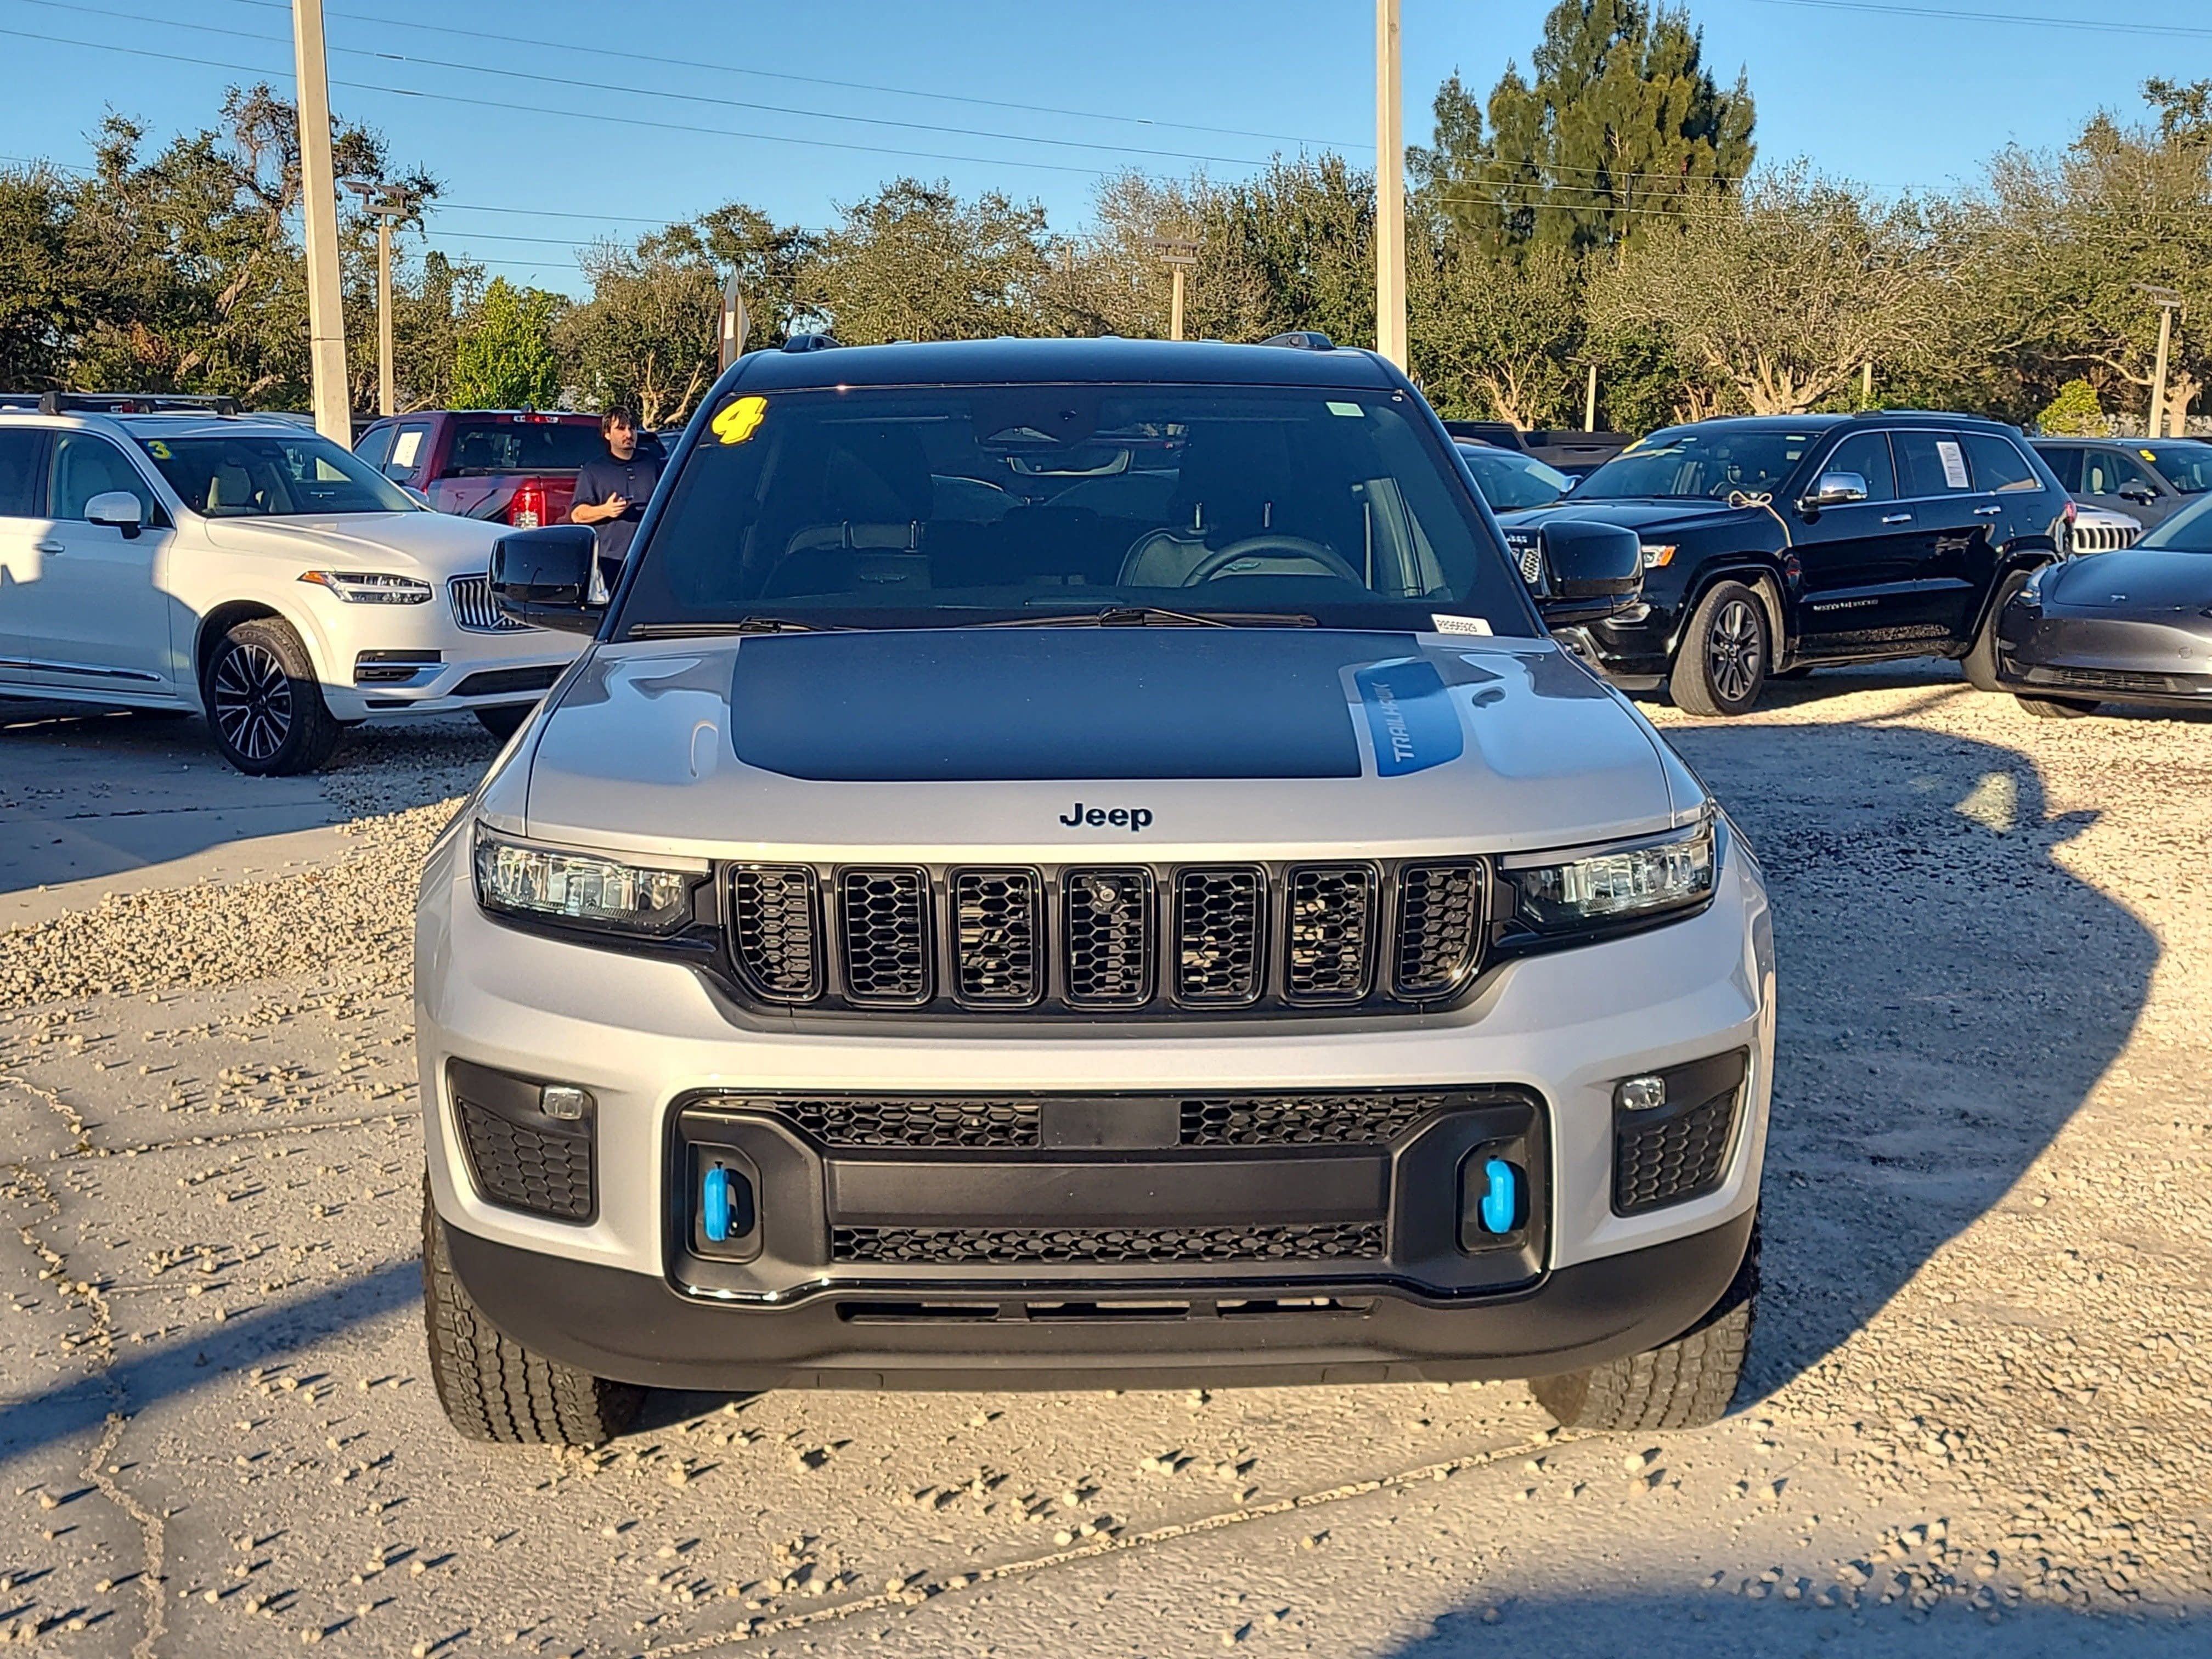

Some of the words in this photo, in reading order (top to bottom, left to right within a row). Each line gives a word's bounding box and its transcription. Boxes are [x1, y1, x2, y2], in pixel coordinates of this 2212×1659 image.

[712, 397, 768, 444] 4
[148, 441, 172, 459] 3
[2139, 449, 2157, 461] 5
[1372, 682, 1415, 763] TRAILHAWK
[1059, 803, 1153, 832] Jeep
